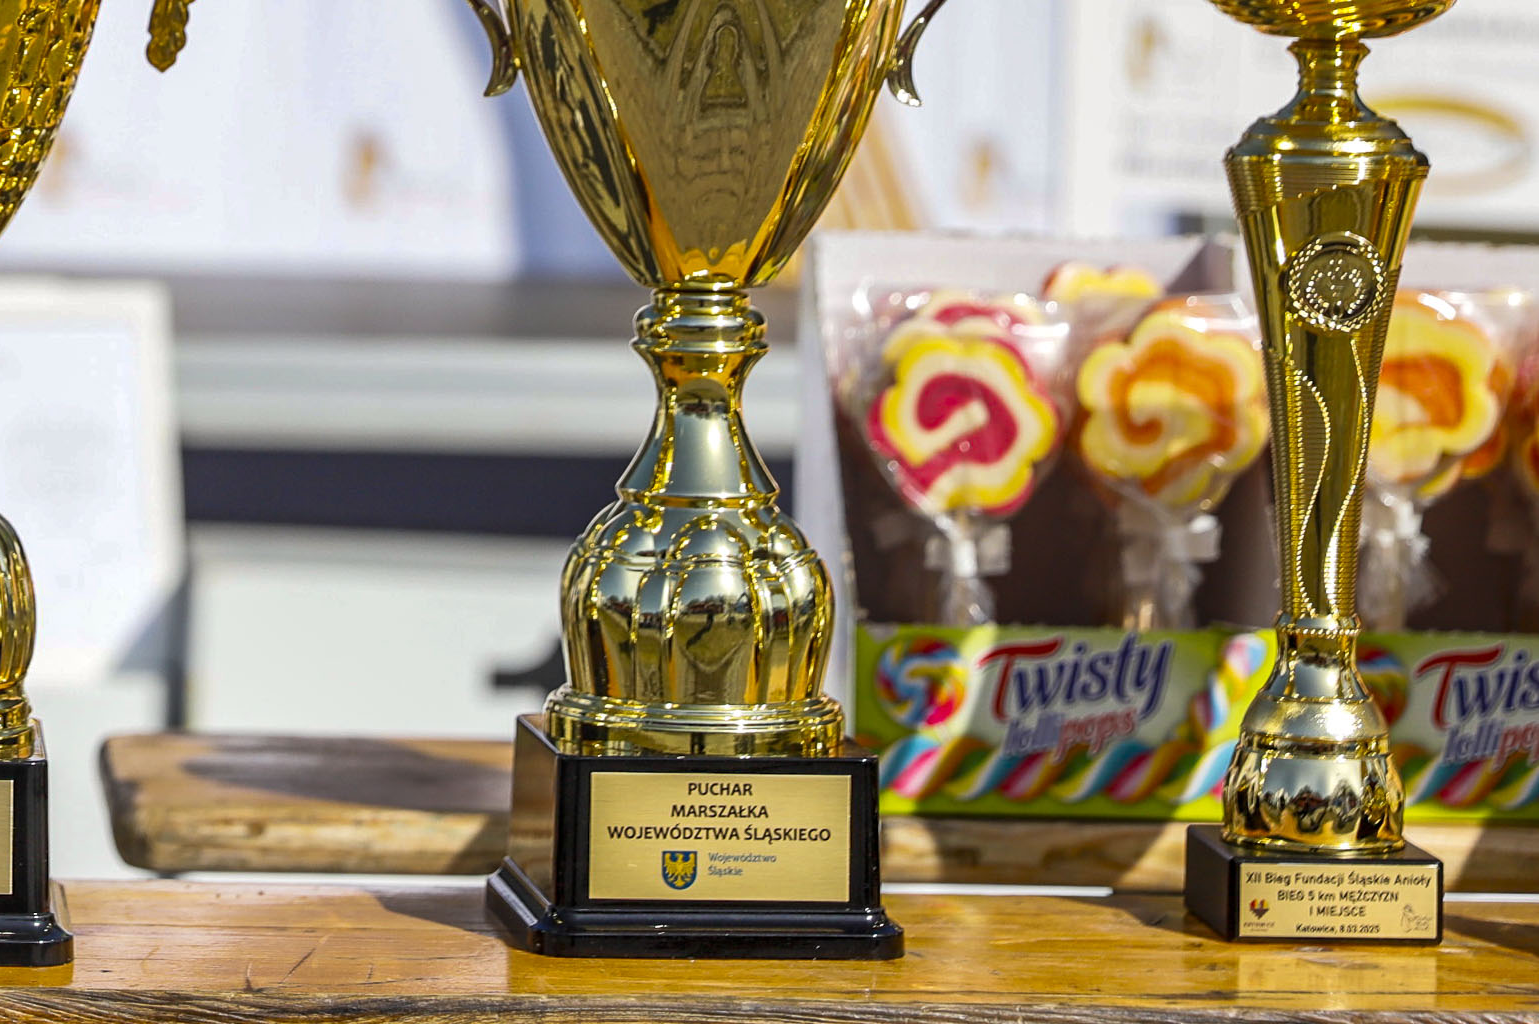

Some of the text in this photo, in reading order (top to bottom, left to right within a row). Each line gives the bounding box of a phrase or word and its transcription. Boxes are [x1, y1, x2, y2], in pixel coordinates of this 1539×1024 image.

[977, 632, 1173, 722] Twisty
[688, 782, 753, 796] PUCHAR
[670, 805, 769, 819] MARSZAŁKA
[607, 824, 831, 845] WOJEWÓDZTWA ŚLĄSKIEGO
[708, 852, 777, 865] Województwo
[708, 865, 743, 877] Śląskie
[1246, 871, 1432, 888] XII Bieg Fundacji Śląskie Anioły
[1277, 890, 1305, 901] BIEG
[1308, 890, 1315, 901] 5
[1318, 890, 1336, 901] km
[1316, 906, 1366, 917] MIEJSCE
